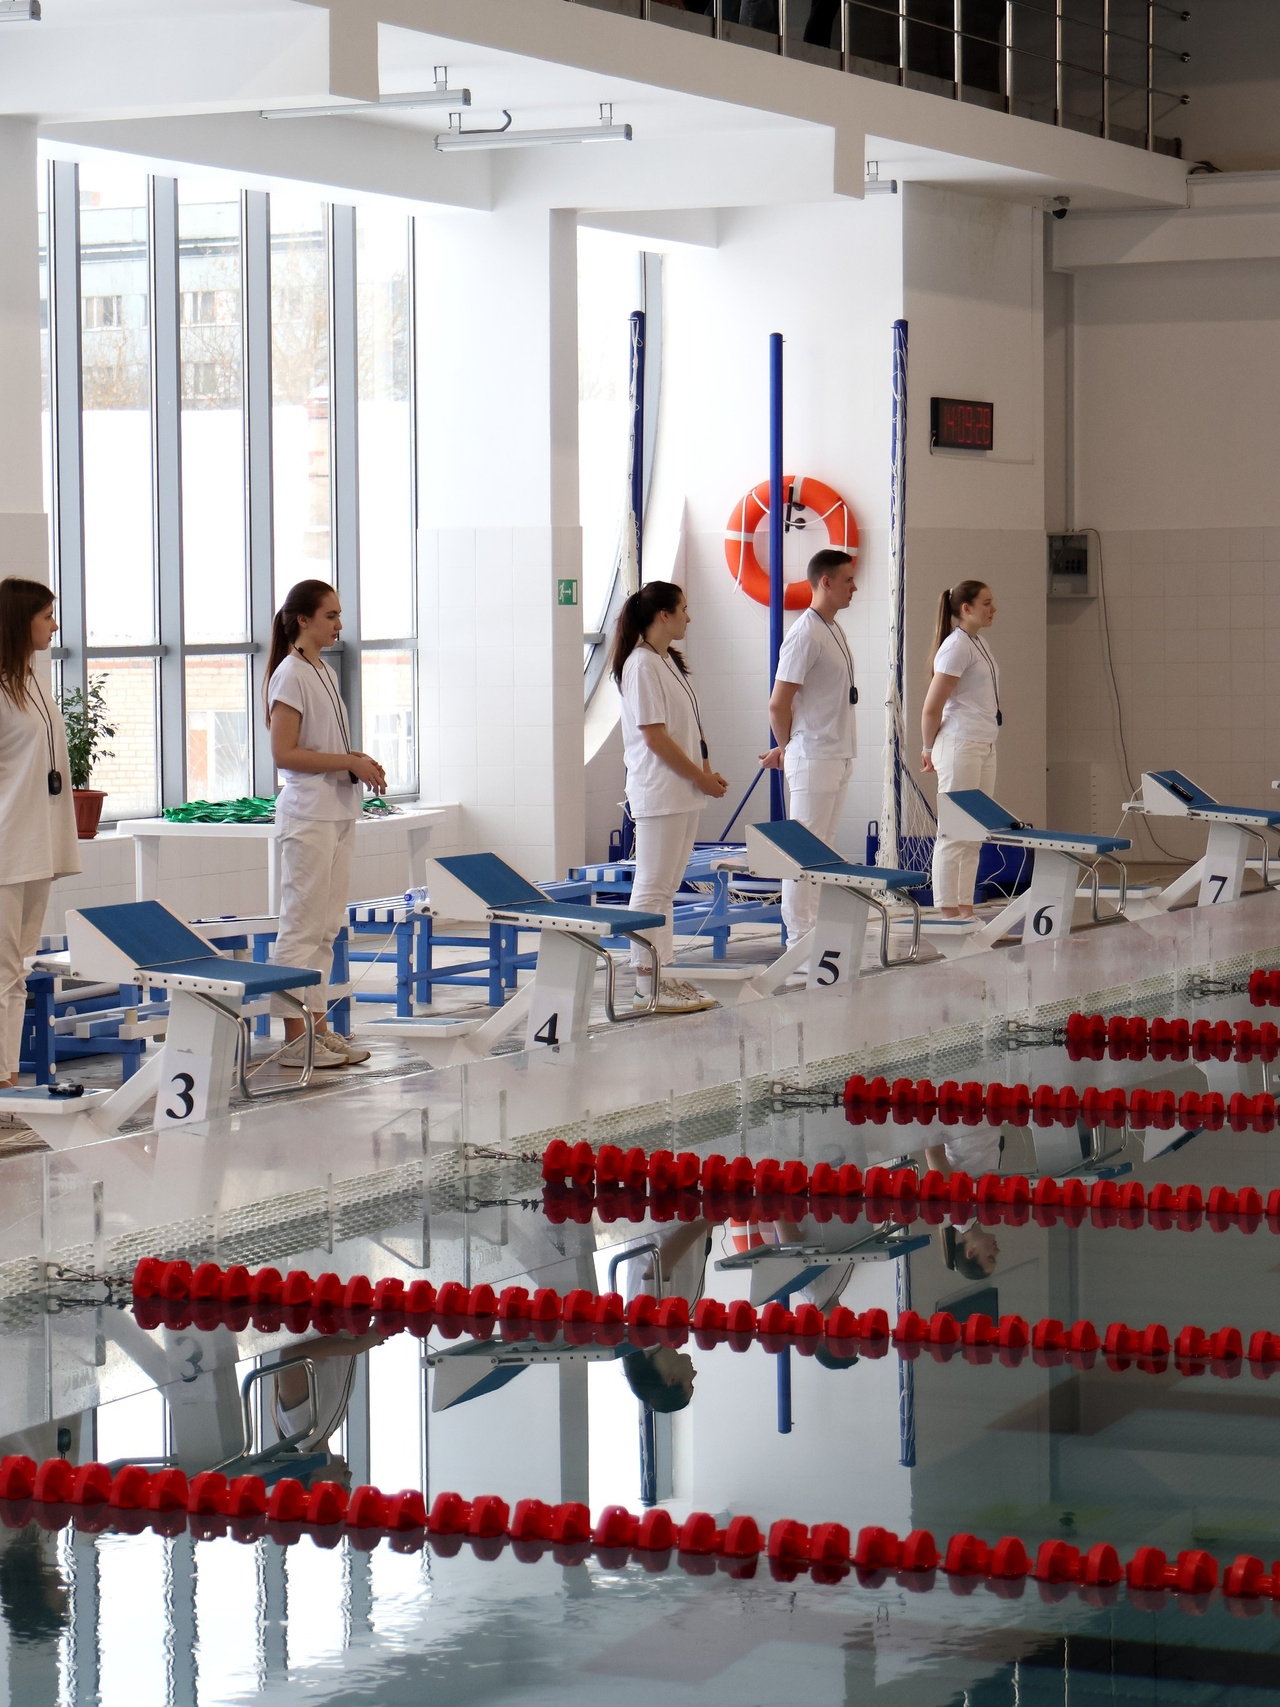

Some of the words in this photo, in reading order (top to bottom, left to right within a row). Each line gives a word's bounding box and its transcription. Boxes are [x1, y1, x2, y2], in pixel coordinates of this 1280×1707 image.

[1208, 874, 1230, 904] 7
[1032, 905, 1055, 936] 6
[816, 950, 841, 986] 5
[533, 1012, 560, 1054] 4
[165, 1072, 195, 1120] 3
